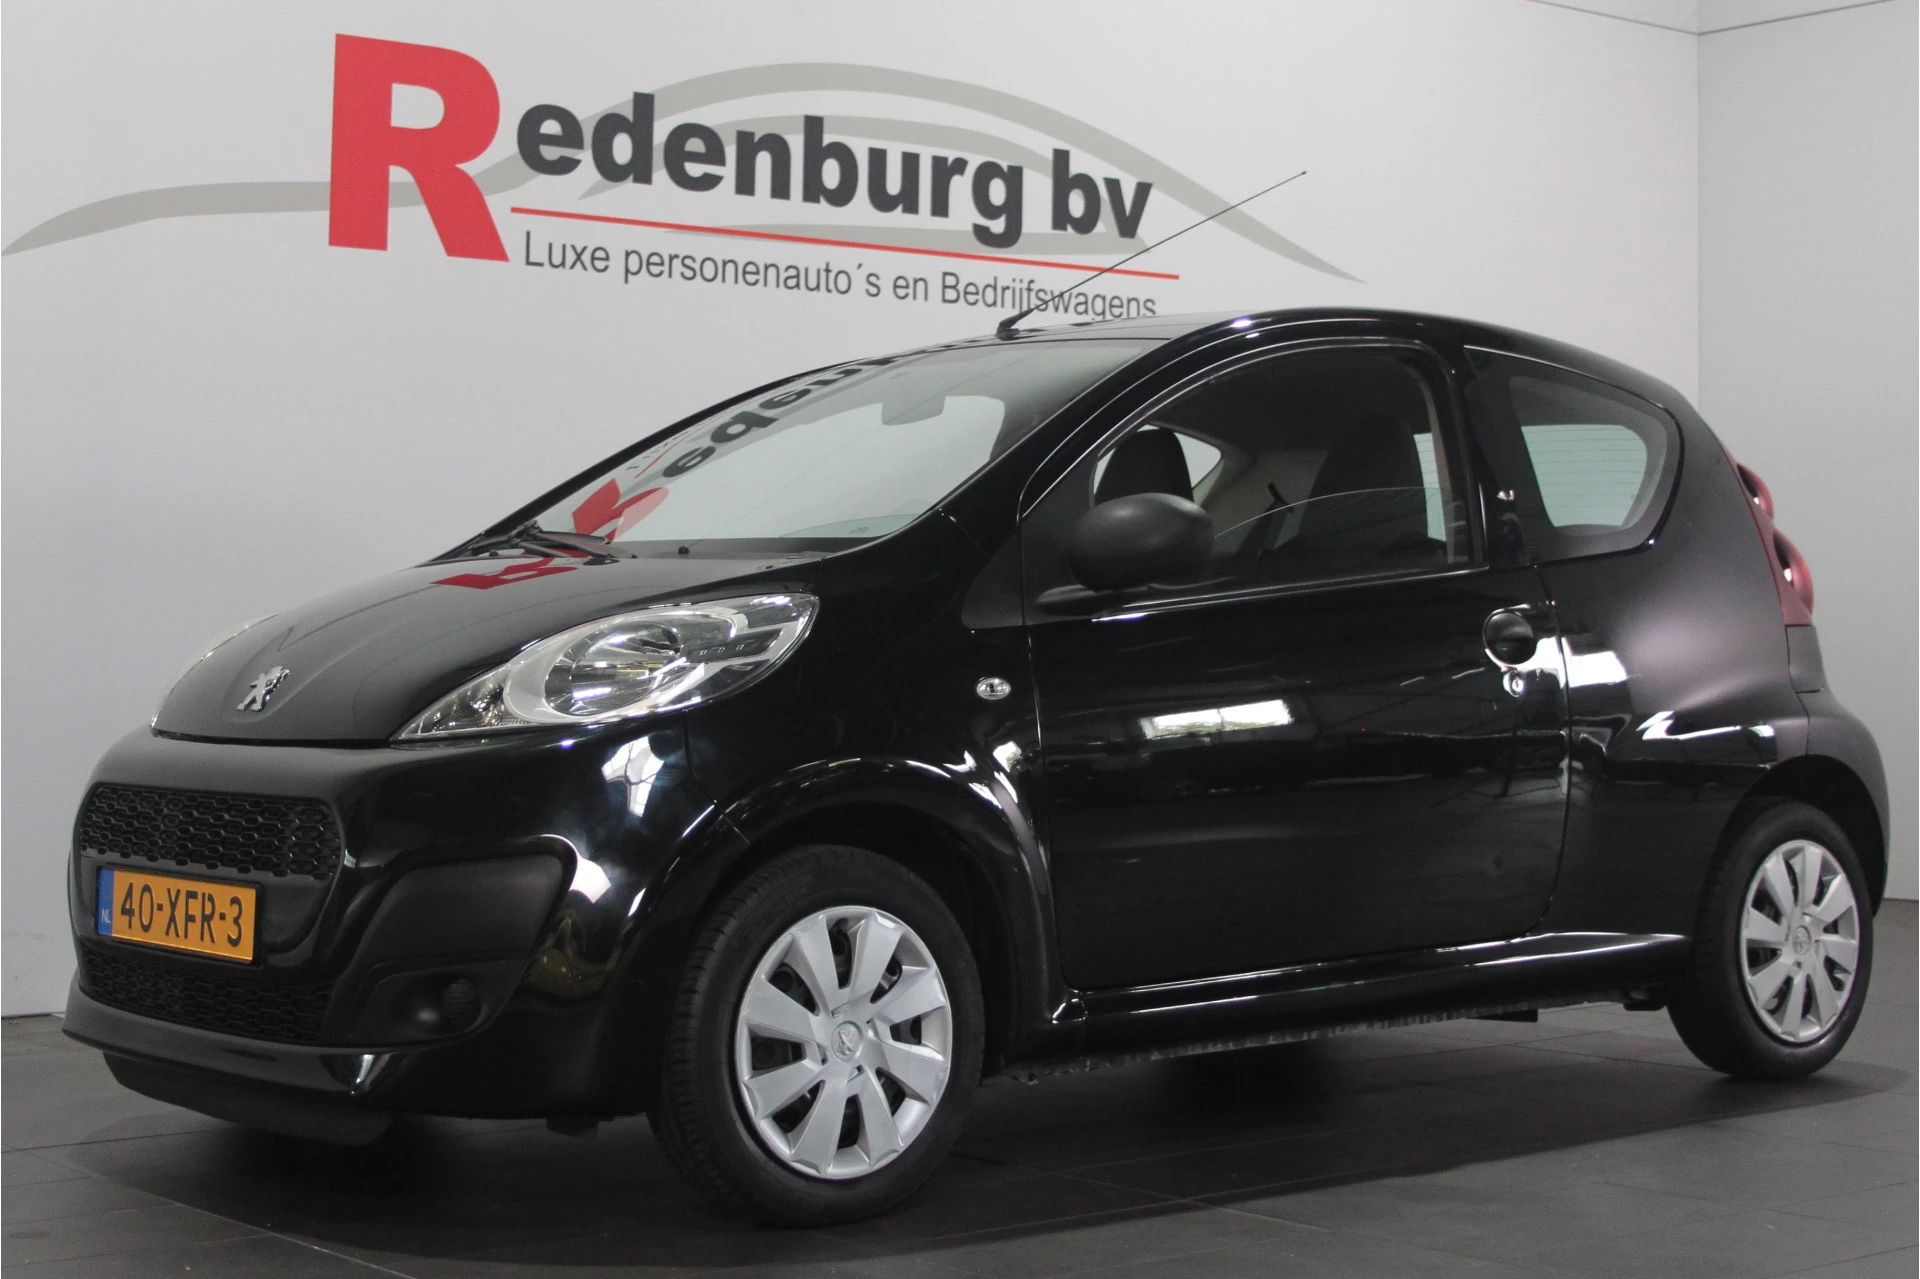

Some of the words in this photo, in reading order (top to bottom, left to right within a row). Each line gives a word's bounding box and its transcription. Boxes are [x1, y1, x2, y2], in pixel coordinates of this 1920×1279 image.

[329, 34, 1023, 262] Redenburg
[1053, 149, 1152, 239] bv
[525, 231, 609, 273] Luxe
[893, 275, 929, 302] en
[101, 908, 112, 924] NL
[120, 882, 243, 948] 40-XFR-3
